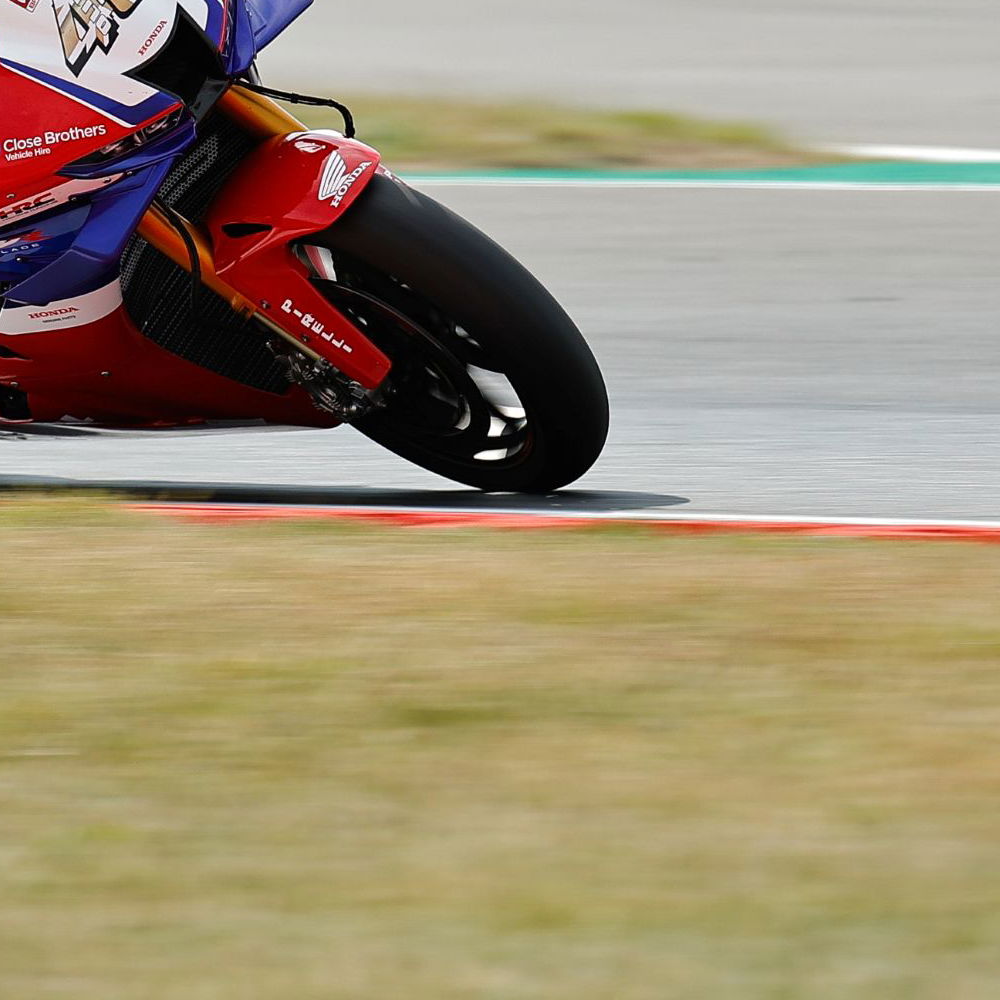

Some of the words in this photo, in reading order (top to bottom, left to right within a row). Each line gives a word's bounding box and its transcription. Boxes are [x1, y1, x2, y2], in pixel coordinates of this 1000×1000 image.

[137, 20, 168, 56] HONDA
[3, 136, 42, 153] Close
[44, 124, 107, 145] Brothers
[4, 148, 33, 162] Vehicle
[33, 147, 51, 157] Hire
[330, 161, 372, 208] HONDA
[28, 306, 80, 319] HONDA
[281, 299, 353, 353] PIRELLI
